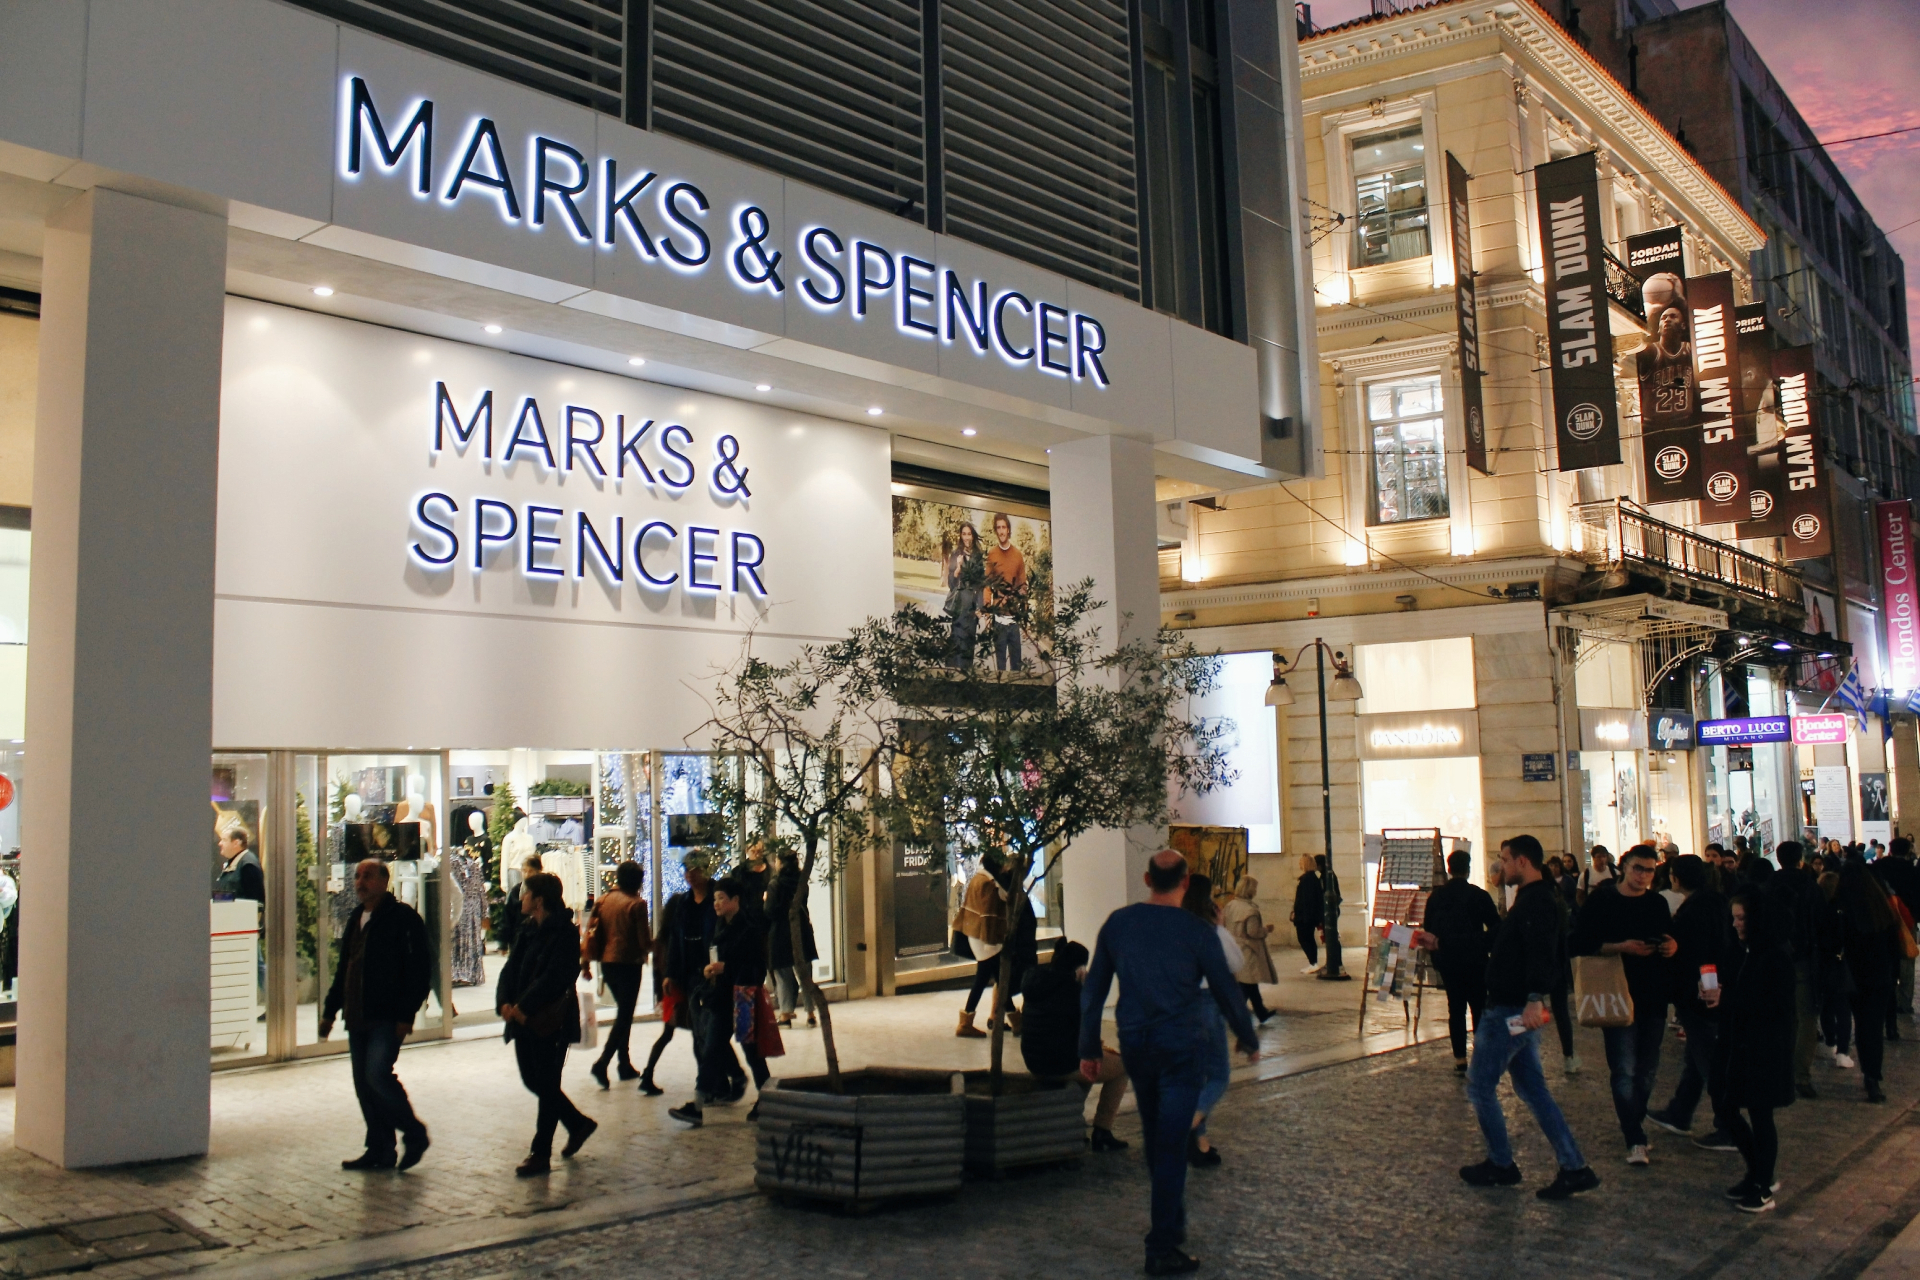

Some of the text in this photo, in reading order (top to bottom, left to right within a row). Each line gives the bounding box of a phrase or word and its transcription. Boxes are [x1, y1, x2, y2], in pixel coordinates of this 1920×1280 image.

[342, 76, 1110, 387] MARKS & SPENCER
[1630, 241, 1679, 260] JORDAN
[1630, 250, 1680, 267] COLLECTION
[1455, 196, 1478, 372] SLAM DUNK
[1549, 195, 1598, 369] SLAM DUNK
[1740, 323, 1765, 334] GAME
[1693, 303, 1735, 445] SLAM DUNK
[1656, 386, 1688, 413] 23
[1574, 411, 1595, 423] SLAM
[1575, 421, 1595, 431] DUNK
[1779, 372, 1817, 492] SLAM DUNK
[431, 380, 752, 498] MARKS &
[1661, 453, 1680, 463] SLAM
[1663, 462, 1681, 471] DUNK
[1713, 478, 1731, 488] SLAM
[1750, 496, 1766, 505] SLAM
[1798, 519, 1814, 528] SLAM
[410, 491, 768, 596] SPENCER
[1885, 512, 1916, 677] Hondos Center
[1702, 721, 1785, 736] BERTO LUCCI
[1796, 718, 1843, 733] Hondos
[1797, 730, 1839, 741] Center
[904, 854, 932, 867] FRIDA
